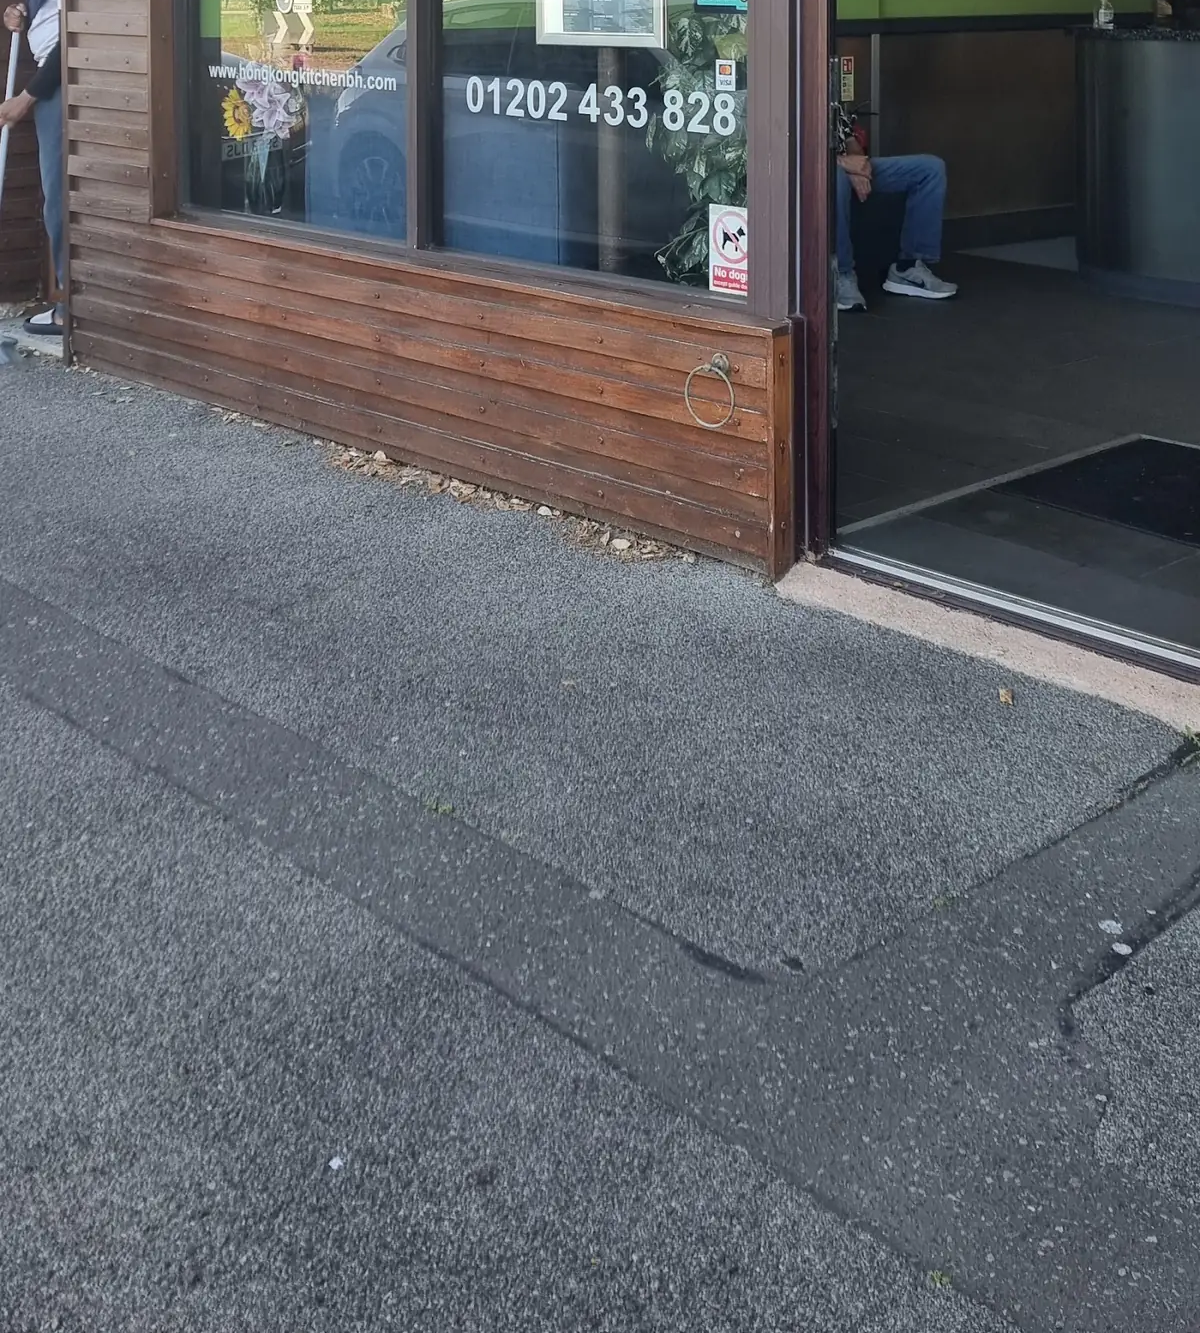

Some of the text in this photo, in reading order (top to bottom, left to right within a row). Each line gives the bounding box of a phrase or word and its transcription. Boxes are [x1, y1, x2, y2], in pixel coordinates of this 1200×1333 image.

[208, 61, 397, 91] www.hongkongkitchenbh.com
[466, 76, 736, 136] 01202 433 828
[714, 266, 748, 283] No dog
